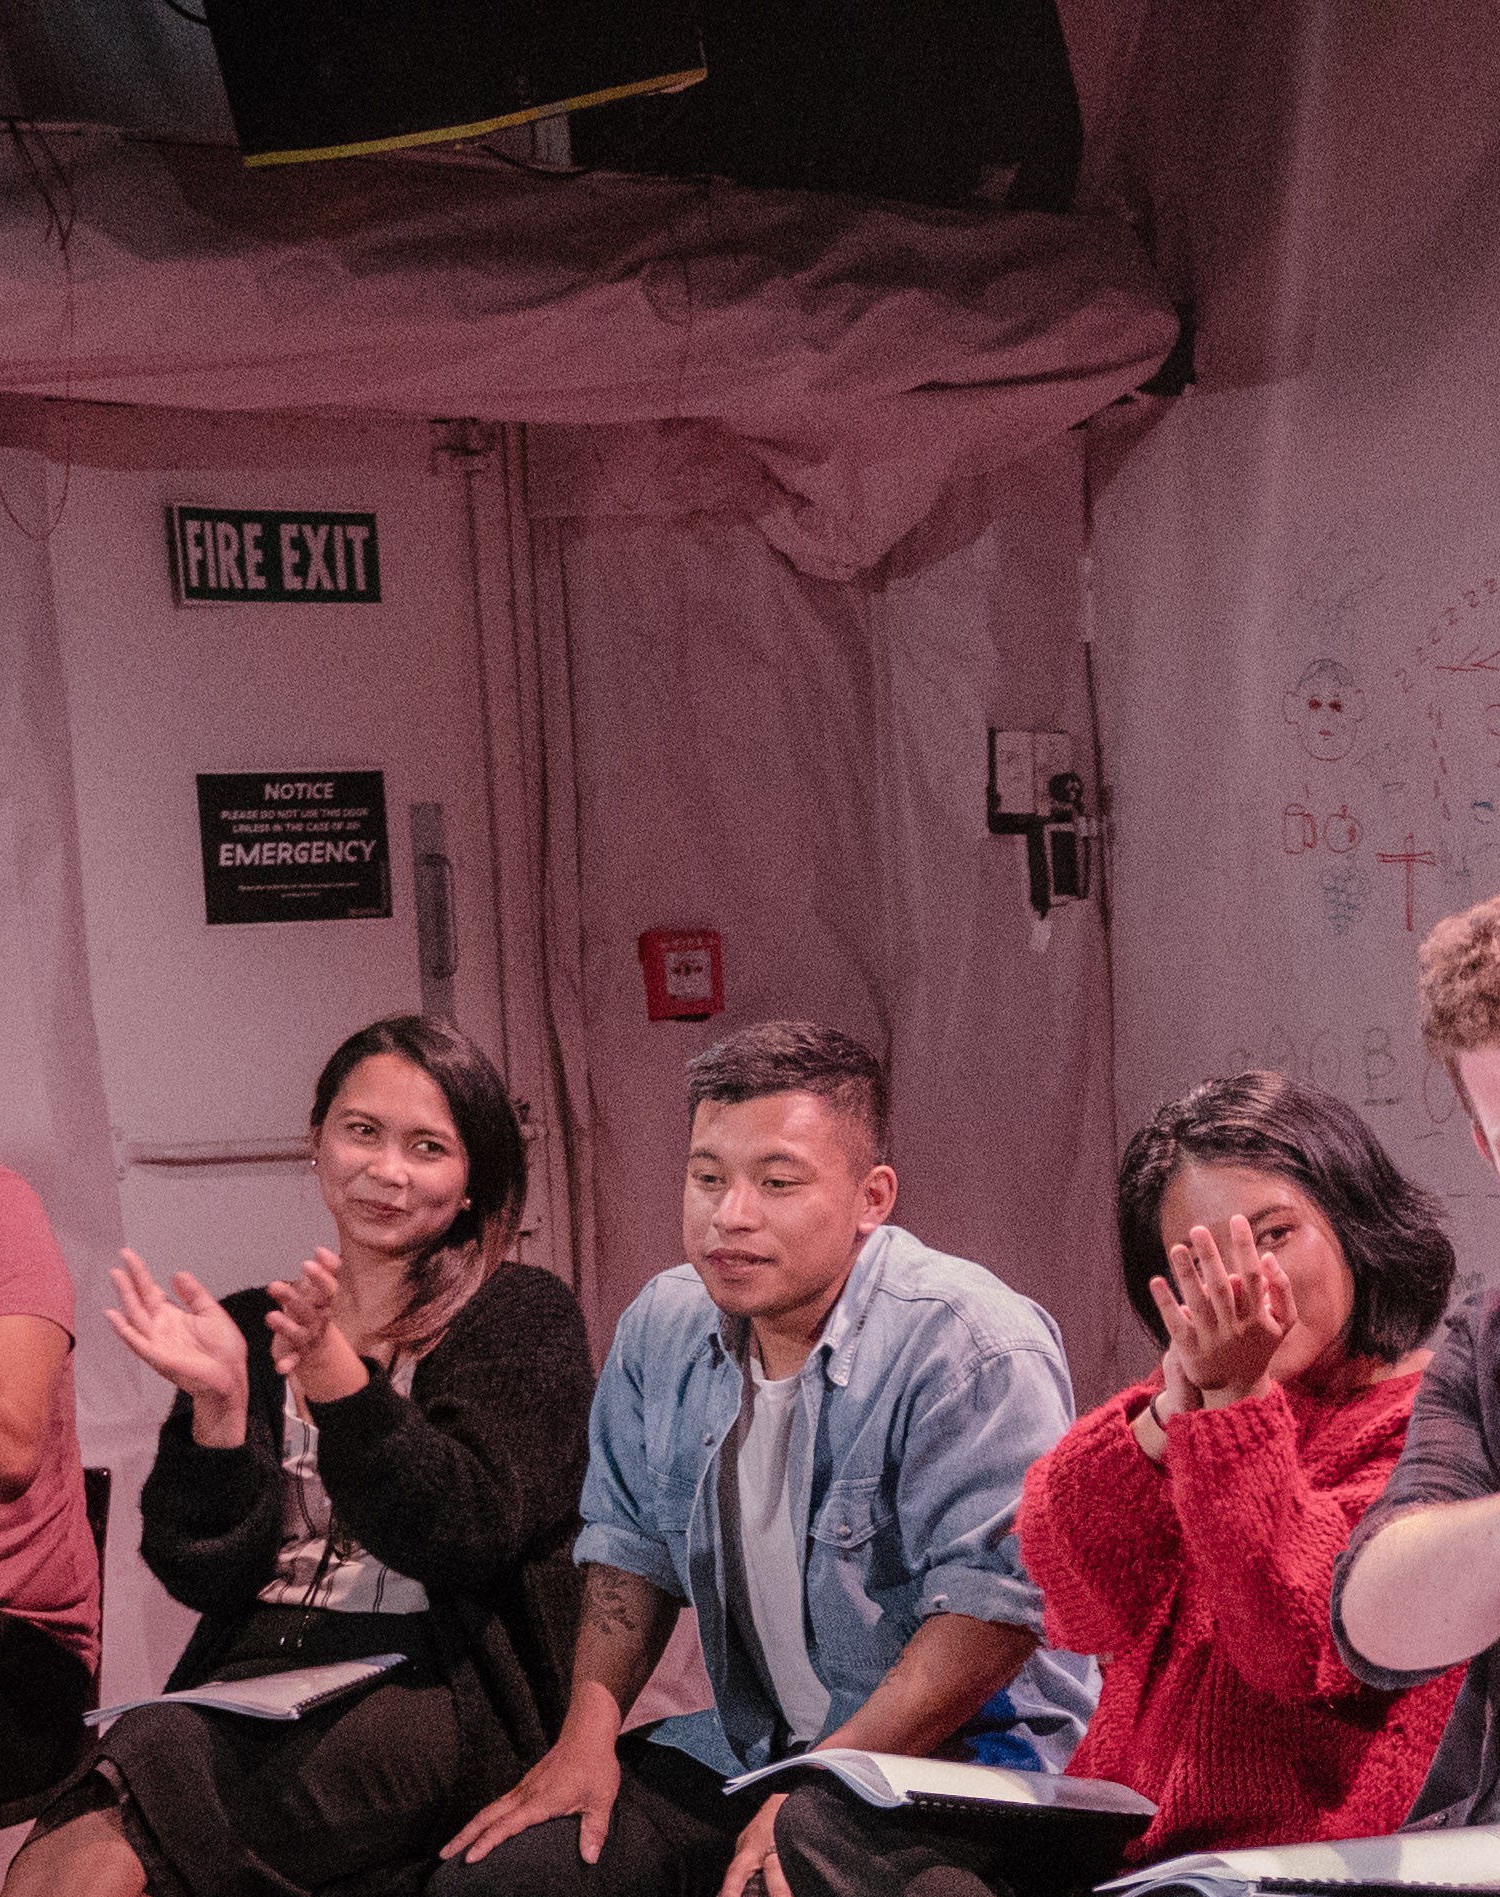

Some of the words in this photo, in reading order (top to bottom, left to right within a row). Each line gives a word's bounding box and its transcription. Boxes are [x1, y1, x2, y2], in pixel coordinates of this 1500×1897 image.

[185, 520, 266, 590] FIRE
[280, 523, 370, 591] EXIT
[264, 782, 335, 801] NOTICE
[221, 809, 258, 820] PLEASE
[260, 809, 276, 819] DO
[277, 809, 298, 819] NOT
[320, 808, 341, 818] THIS
[218, 839, 377, 868] EMERGENCY
